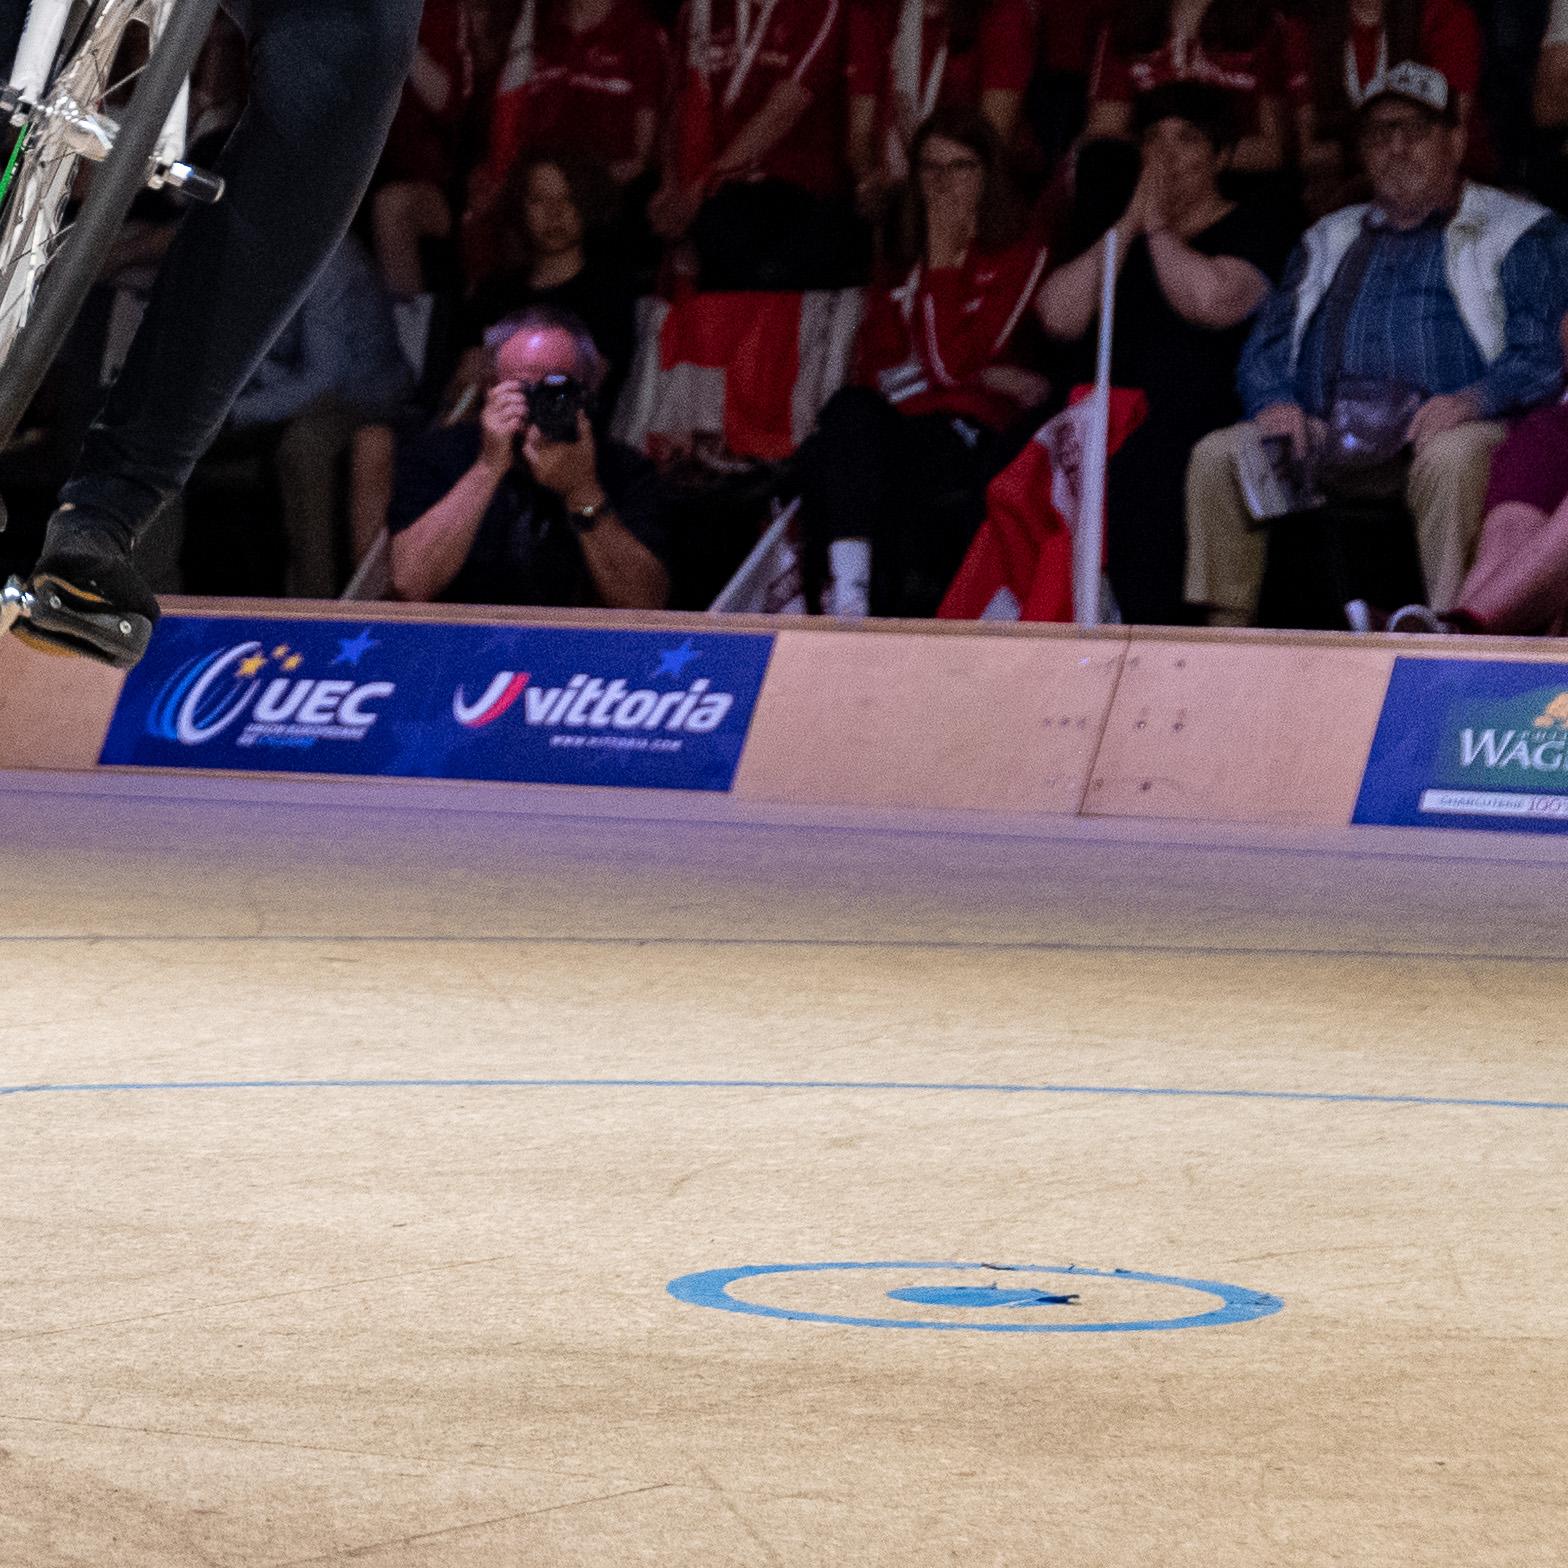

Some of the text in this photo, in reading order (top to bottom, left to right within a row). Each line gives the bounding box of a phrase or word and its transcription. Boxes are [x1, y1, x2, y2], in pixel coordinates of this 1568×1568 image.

[252, 677, 396, 726] UEC
[524, 673, 734, 732] vittoria
[1460, 728, 1568, 772] WAG
